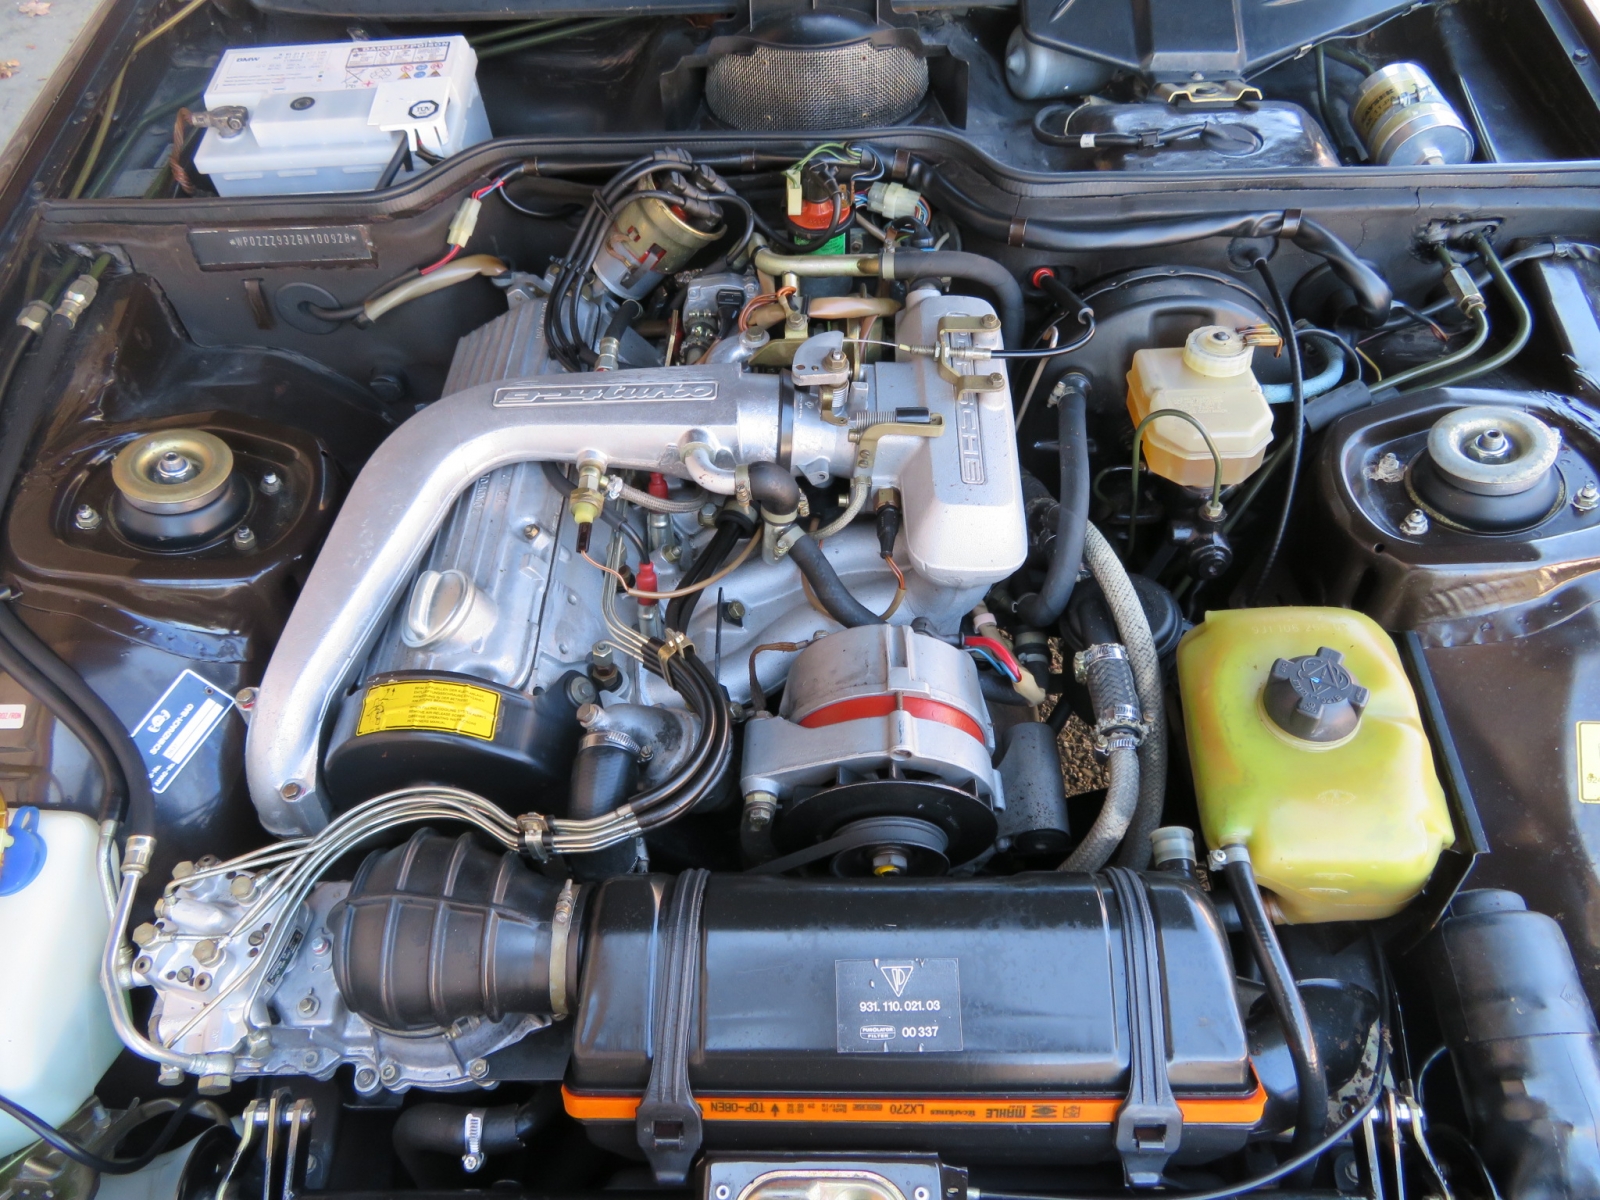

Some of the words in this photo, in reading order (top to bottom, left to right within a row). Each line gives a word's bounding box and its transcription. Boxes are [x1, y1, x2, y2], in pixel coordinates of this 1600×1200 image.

[859, 1001, 880, 1012] 931.
[882, 1001, 902, 1012] 110.
[904, 1000, 924, 1011] 021.
[926, 1000, 941, 1011] 03
[710, 1102, 765, 1113] TOP-OBEN
[889, 1103, 925, 1115] LX270
[985, 1107, 1026, 1118] MAHLE
